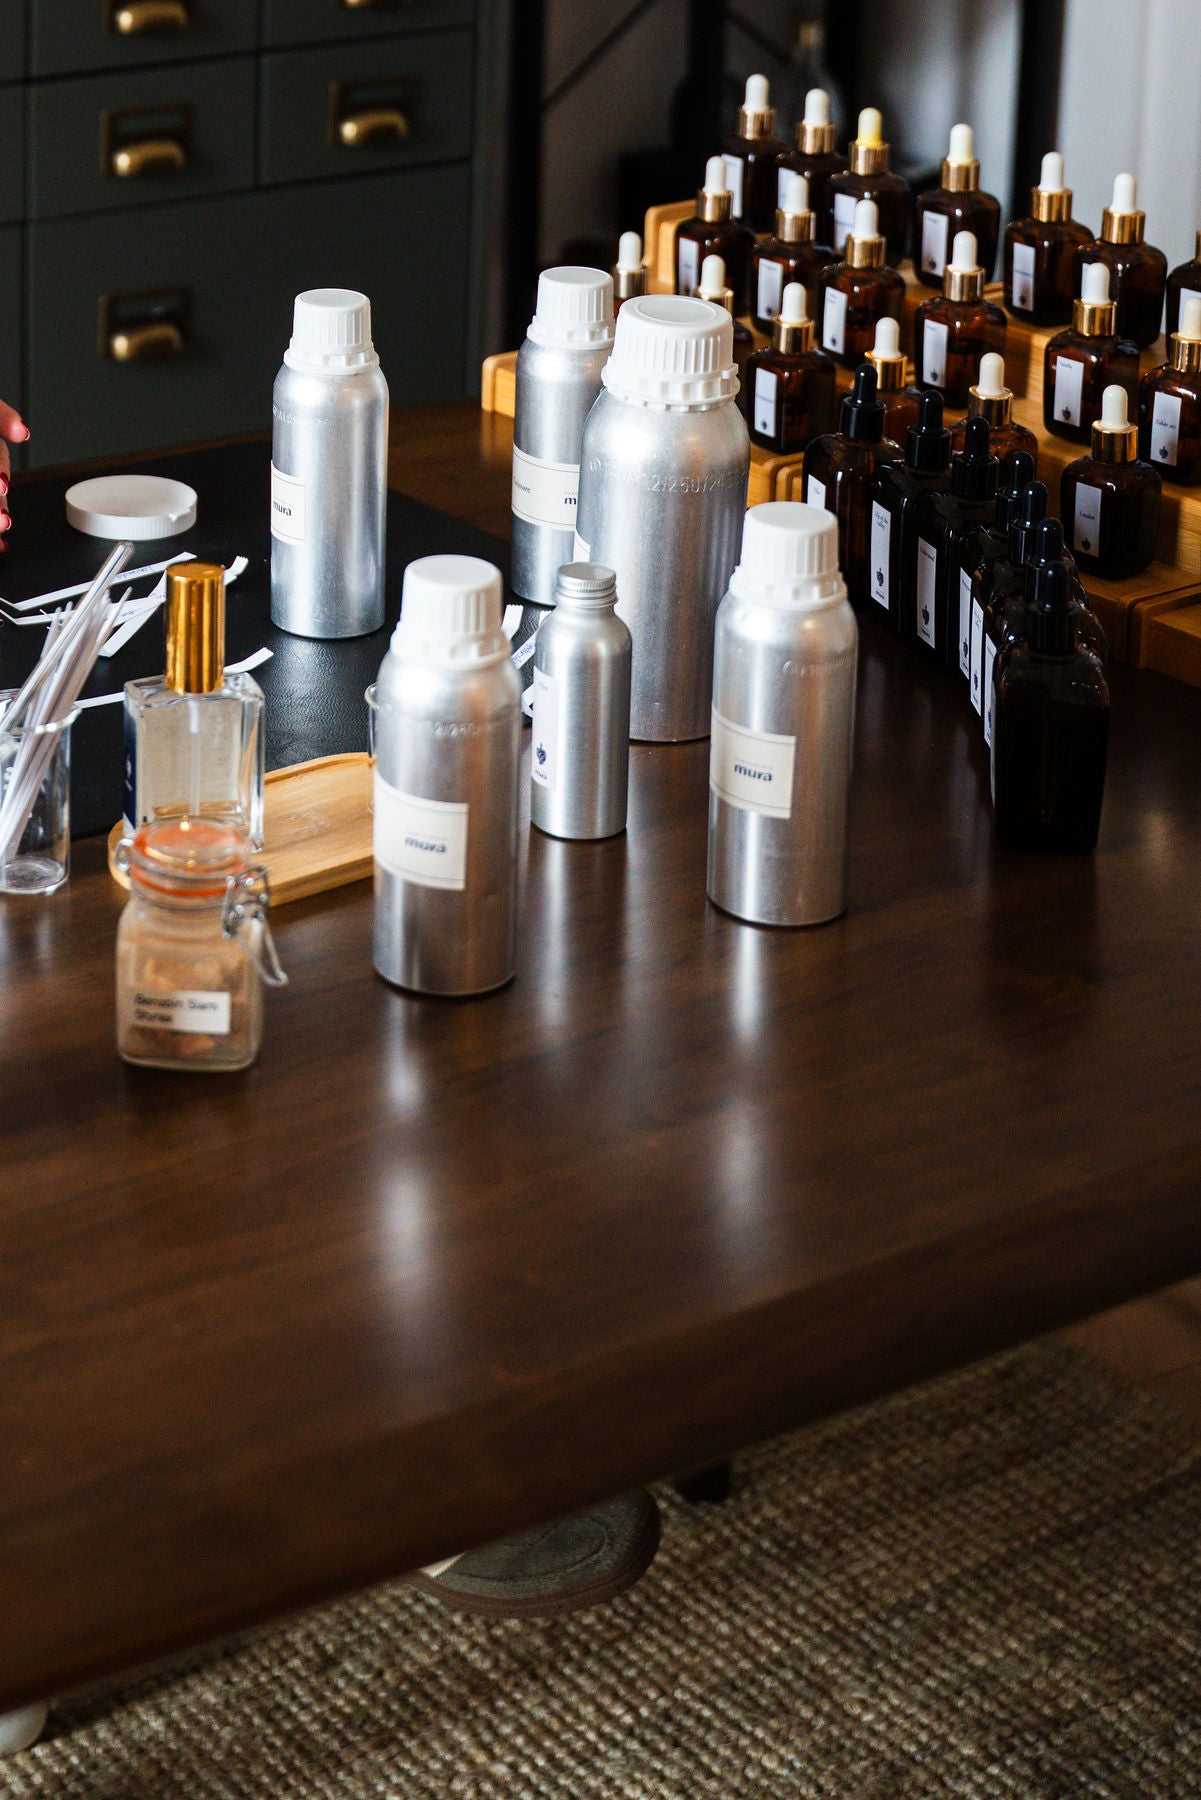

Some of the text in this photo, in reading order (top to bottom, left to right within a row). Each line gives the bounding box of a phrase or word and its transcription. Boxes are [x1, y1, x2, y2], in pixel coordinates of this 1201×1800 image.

[273, 500, 292, 517] mura
[733, 762, 773, 782] mura
[404, 836, 447, 854] mura
